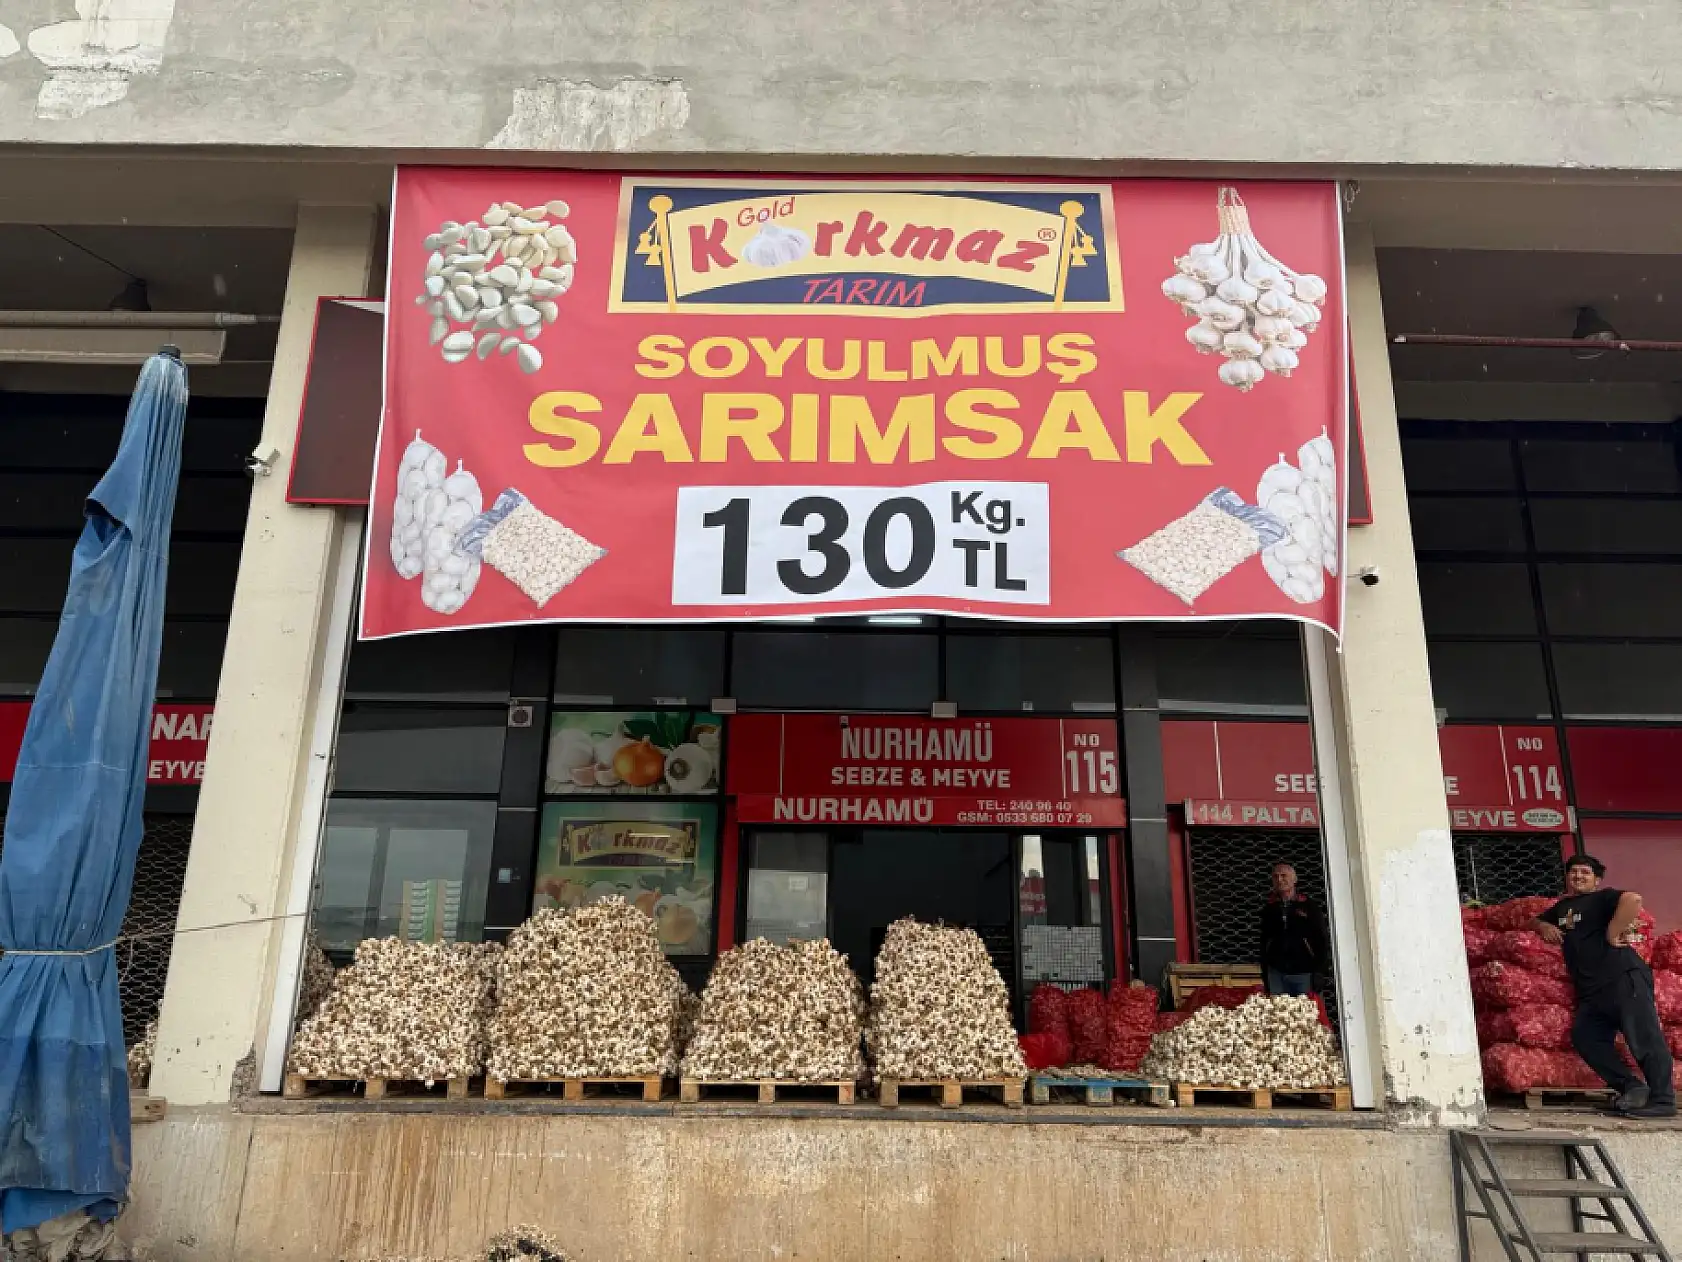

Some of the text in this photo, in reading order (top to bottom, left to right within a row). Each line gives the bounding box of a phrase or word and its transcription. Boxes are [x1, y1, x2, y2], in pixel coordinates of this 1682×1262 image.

[737, 196, 795, 227] Gold
[802, 278, 925, 307] TARIM
[634, 332, 1098, 385] SOYULMUŞ
[522, 390, 1212, 468] SARIMSAK
[952, 491, 1026, 530] Kg.
[702, 496, 936, 598] 130
[956, 540, 1027, 592] TL
[841, 723, 993, 763] NURHAMÜ
[1073, 733, 1100, 748] NO
[1517, 737, 1543, 751] NO
[831, 767, 1011, 788] SEBZE & MEYVE
[1066, 751, 1118, 794] 115
[1512, 764, 1562, 800] 114
[773, 797, 934, 823] NURHAMÜ
[976, 800, 1006, 811] TEL:
[1199, 803, 1234, 823] 114
